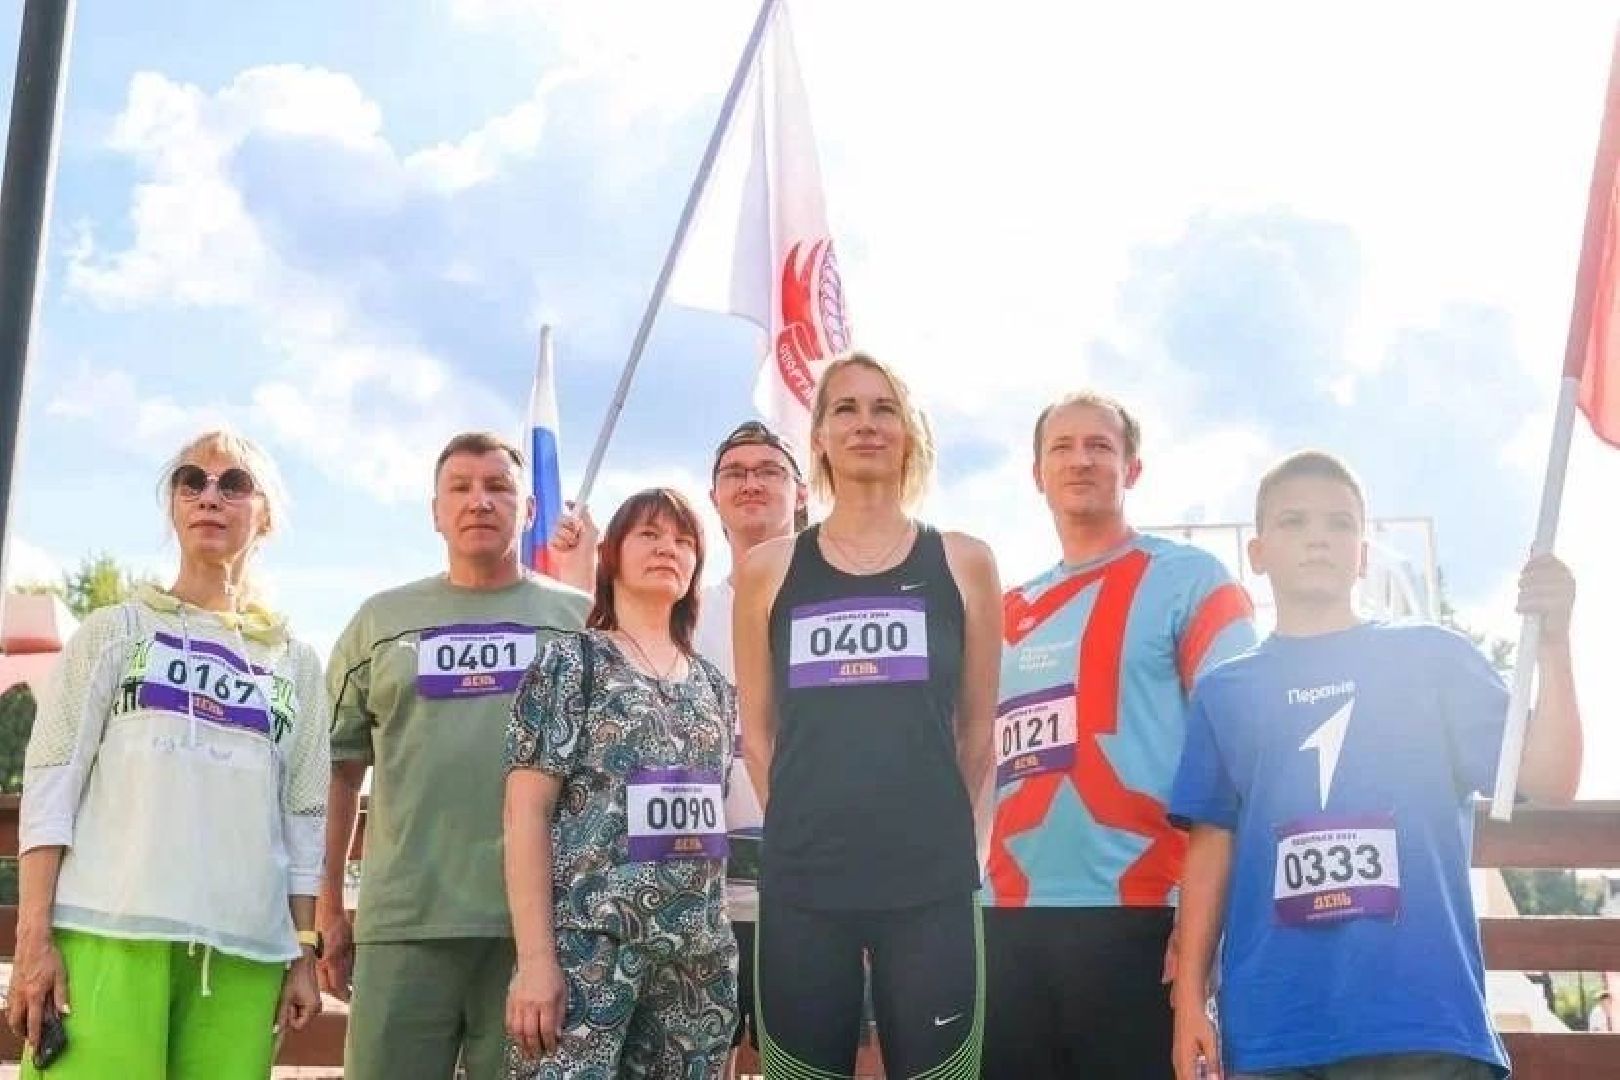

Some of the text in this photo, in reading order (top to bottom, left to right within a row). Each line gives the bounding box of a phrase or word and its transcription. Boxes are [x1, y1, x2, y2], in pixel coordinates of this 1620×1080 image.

[437, 642, 517, 671] 0401
[810, 621, 908, 657] 0400
[167, 658, 255, 705] 0167
[1287, 679, 1356, 705] Первые
[1002, 711, 1059, 757] 0121
[646, 797, 716, 830] 0090
[1284, 844, 1383, 889] 0333
